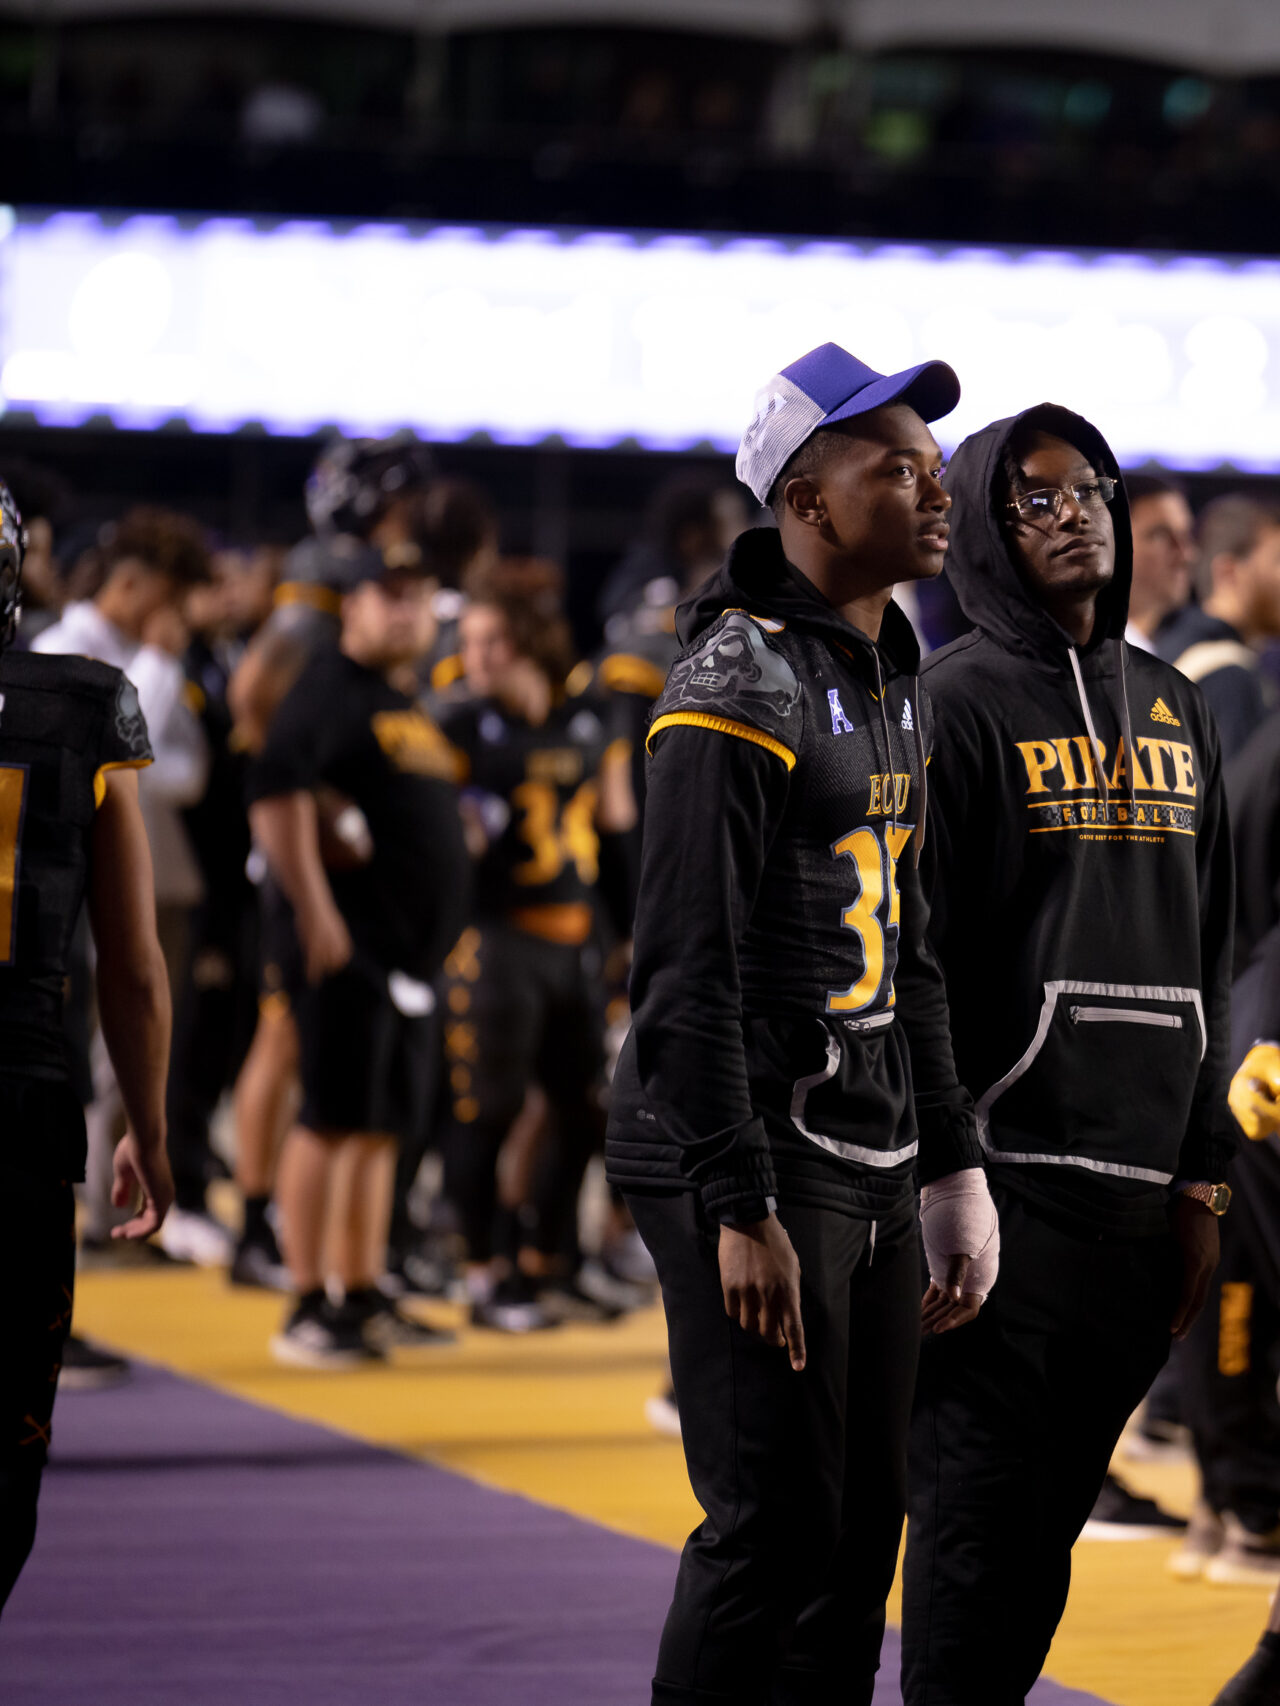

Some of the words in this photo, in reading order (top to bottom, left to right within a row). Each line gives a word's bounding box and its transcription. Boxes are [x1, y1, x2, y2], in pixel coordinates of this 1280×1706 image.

[1150, 712, 1181, 727] adidas
[1013, 736, 1197, 797] PIRATE
[866, 773, 911, 816] ECU
[1125, 834, 1138, 842] THE
